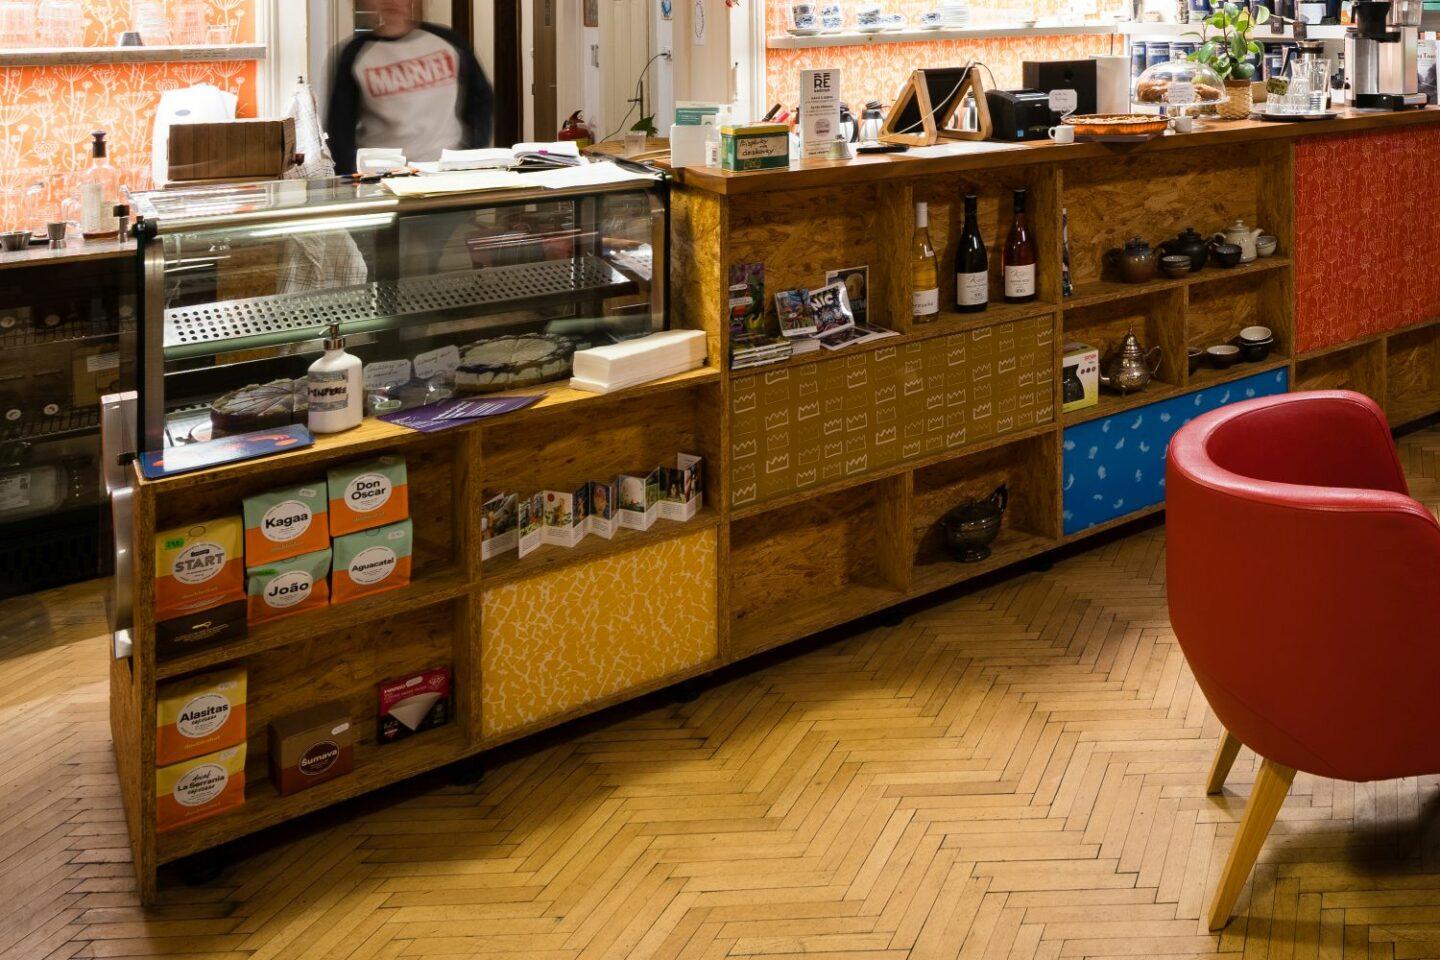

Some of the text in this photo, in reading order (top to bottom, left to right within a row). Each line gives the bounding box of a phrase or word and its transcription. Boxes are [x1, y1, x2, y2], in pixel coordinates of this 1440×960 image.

[367, 51, 453, 95] MARVEL
[355, 479, 381, 491] Don
[351, 486, 387, 502] Oscar
[265, 511, 309, 529] Kagaa
[174, 553, 225, 572] START
[351, 556, 395, 573] Aguacatal
[267, 581, 310, 597] João
[180, 704, 229, 724] Alasitas
